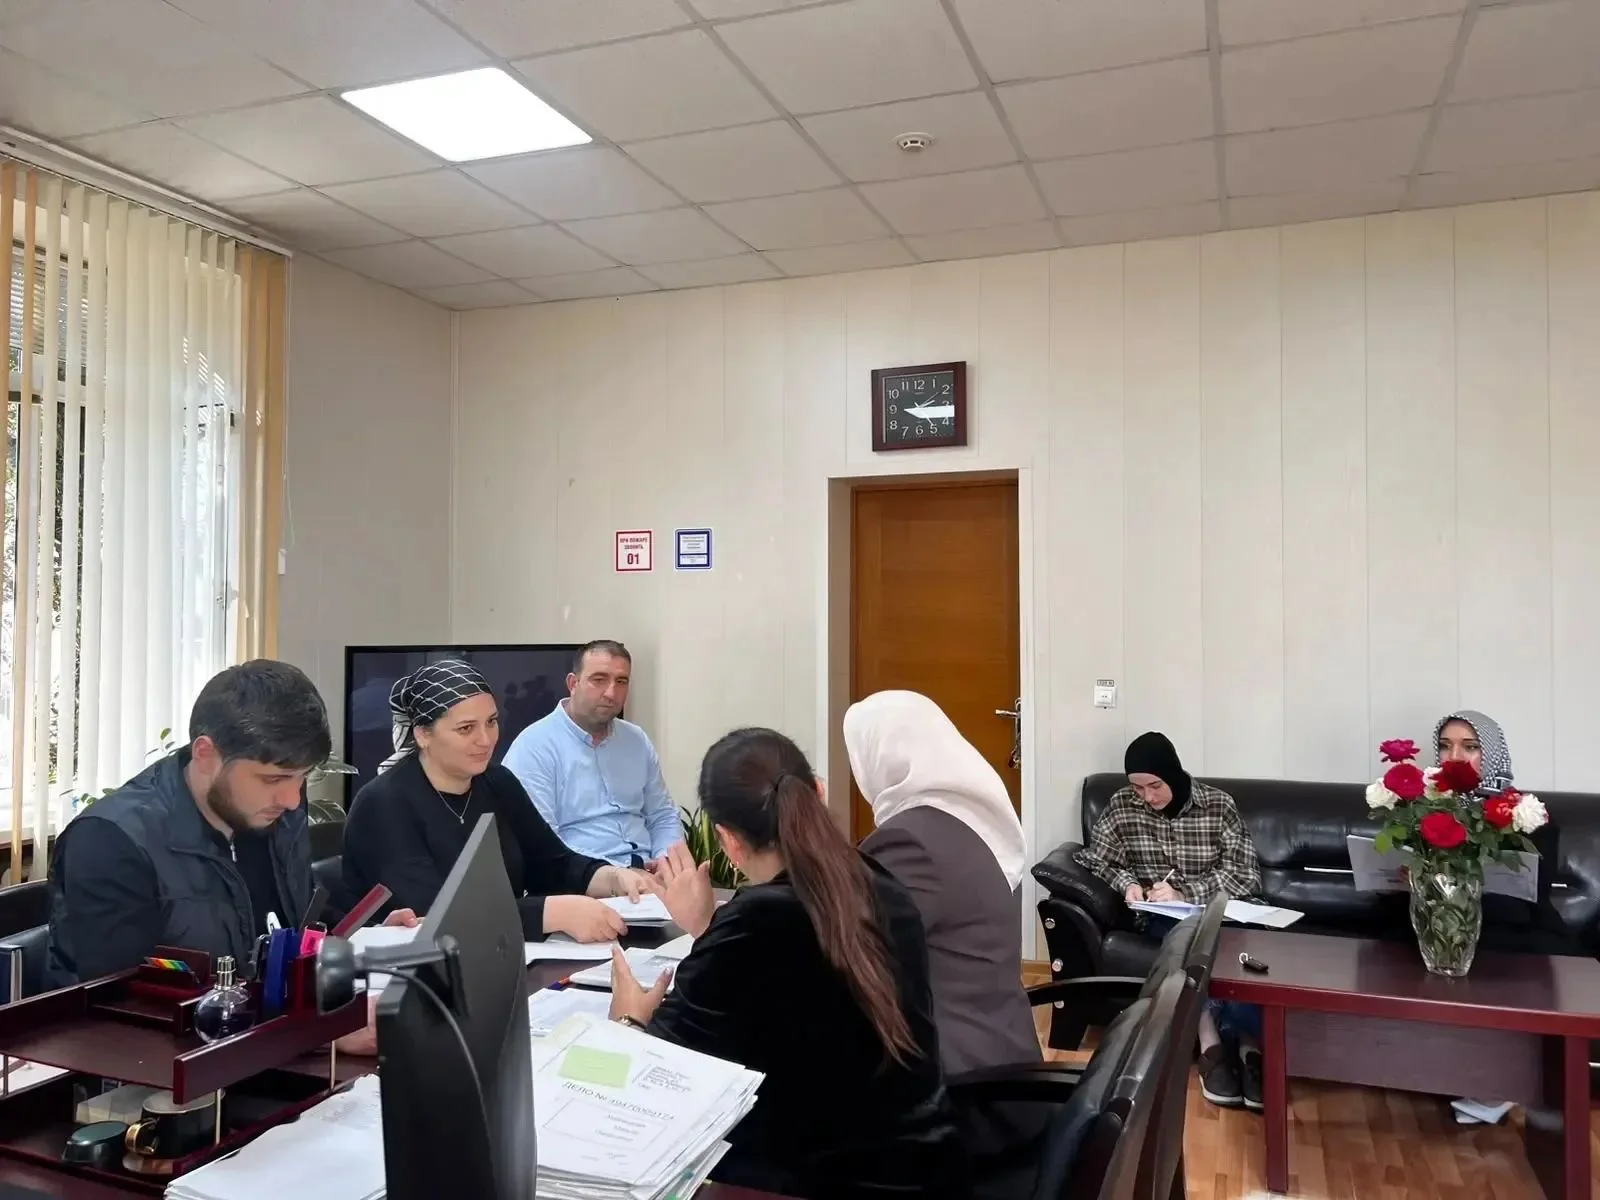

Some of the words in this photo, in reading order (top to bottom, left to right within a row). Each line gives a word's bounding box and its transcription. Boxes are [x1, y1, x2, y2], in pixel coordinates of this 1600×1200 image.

[901, 381, 909, 391] 11
[913, 379, 925, 390] 12
[942, 384, 950, 395] 2
[888, 389, 899, 399] 10
[889, 404, 898, 415] 9
[890, 420, 898, 430] 8
[915, 425, 924, 435] 6
[929, 424, 938, 434] 5
[901, 426, 909, 439] 7
[627, 552, 640, 565] 01
[562, 1081, 593, 1096] ДЕЛО
